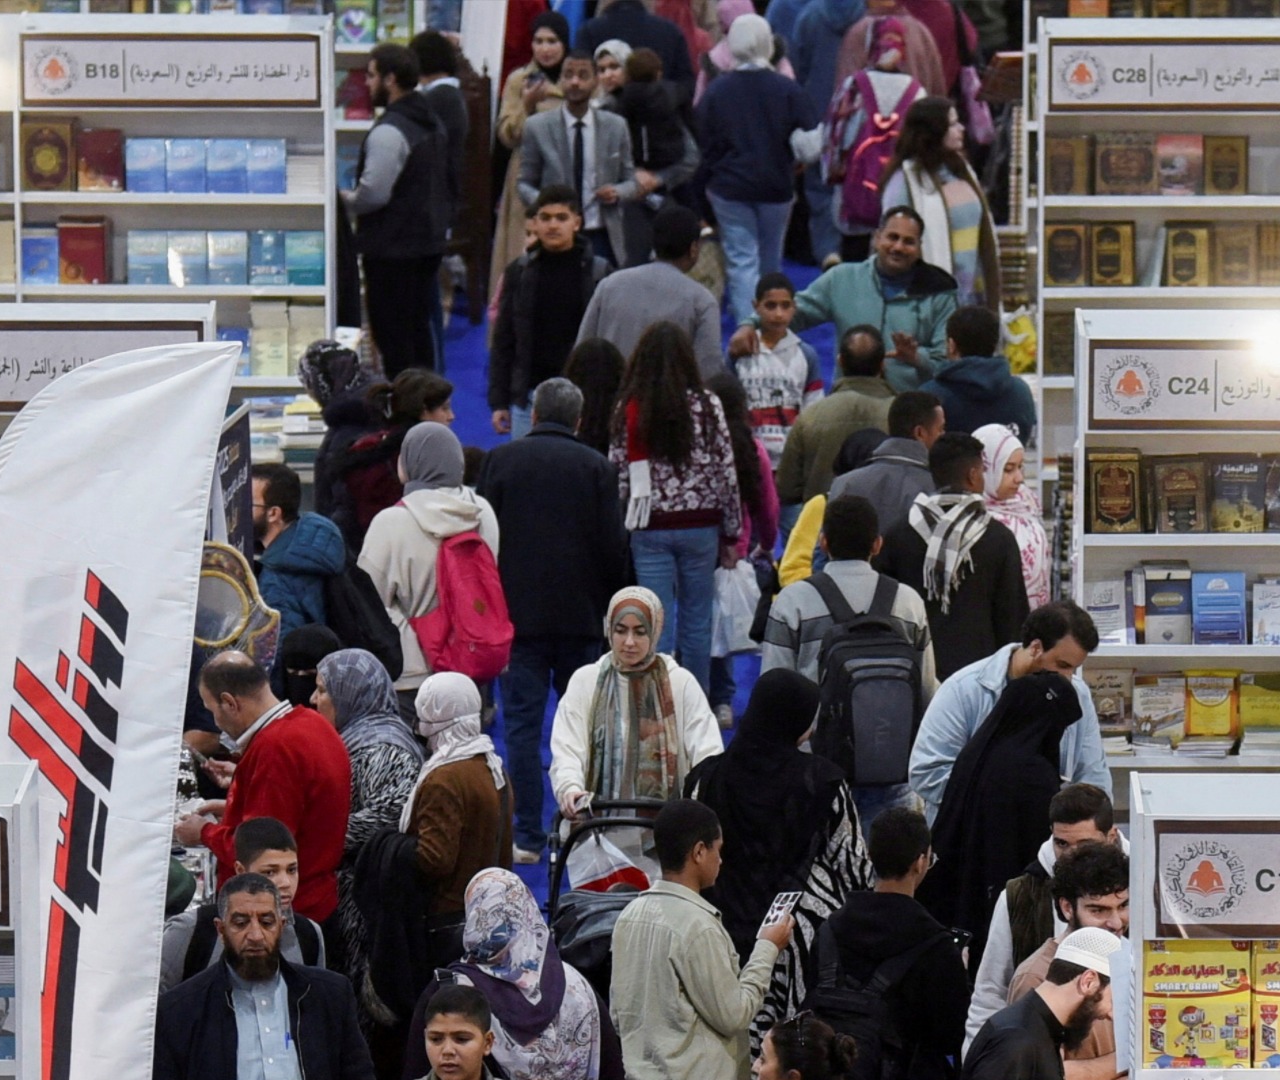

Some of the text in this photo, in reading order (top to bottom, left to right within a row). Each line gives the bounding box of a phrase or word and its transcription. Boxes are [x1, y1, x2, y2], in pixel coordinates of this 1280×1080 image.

[86, 64, 118, 78] B18
[130, 63, 309, 86] دار الحضارة للنشر والتوزيع (السعودية)
[1113, 69, 1146, 83] C28
[1158, 69, 1208, 87] (السعودية)
[1215, 69, 1251, 90] والتوزيع
[1255, 70, 1279, 87] للنشر
[25, 357, 56, 381] والنشر
[1168, 376, 1209, 395] C24
[1221, 377, 1270, 406] والتوزيع
